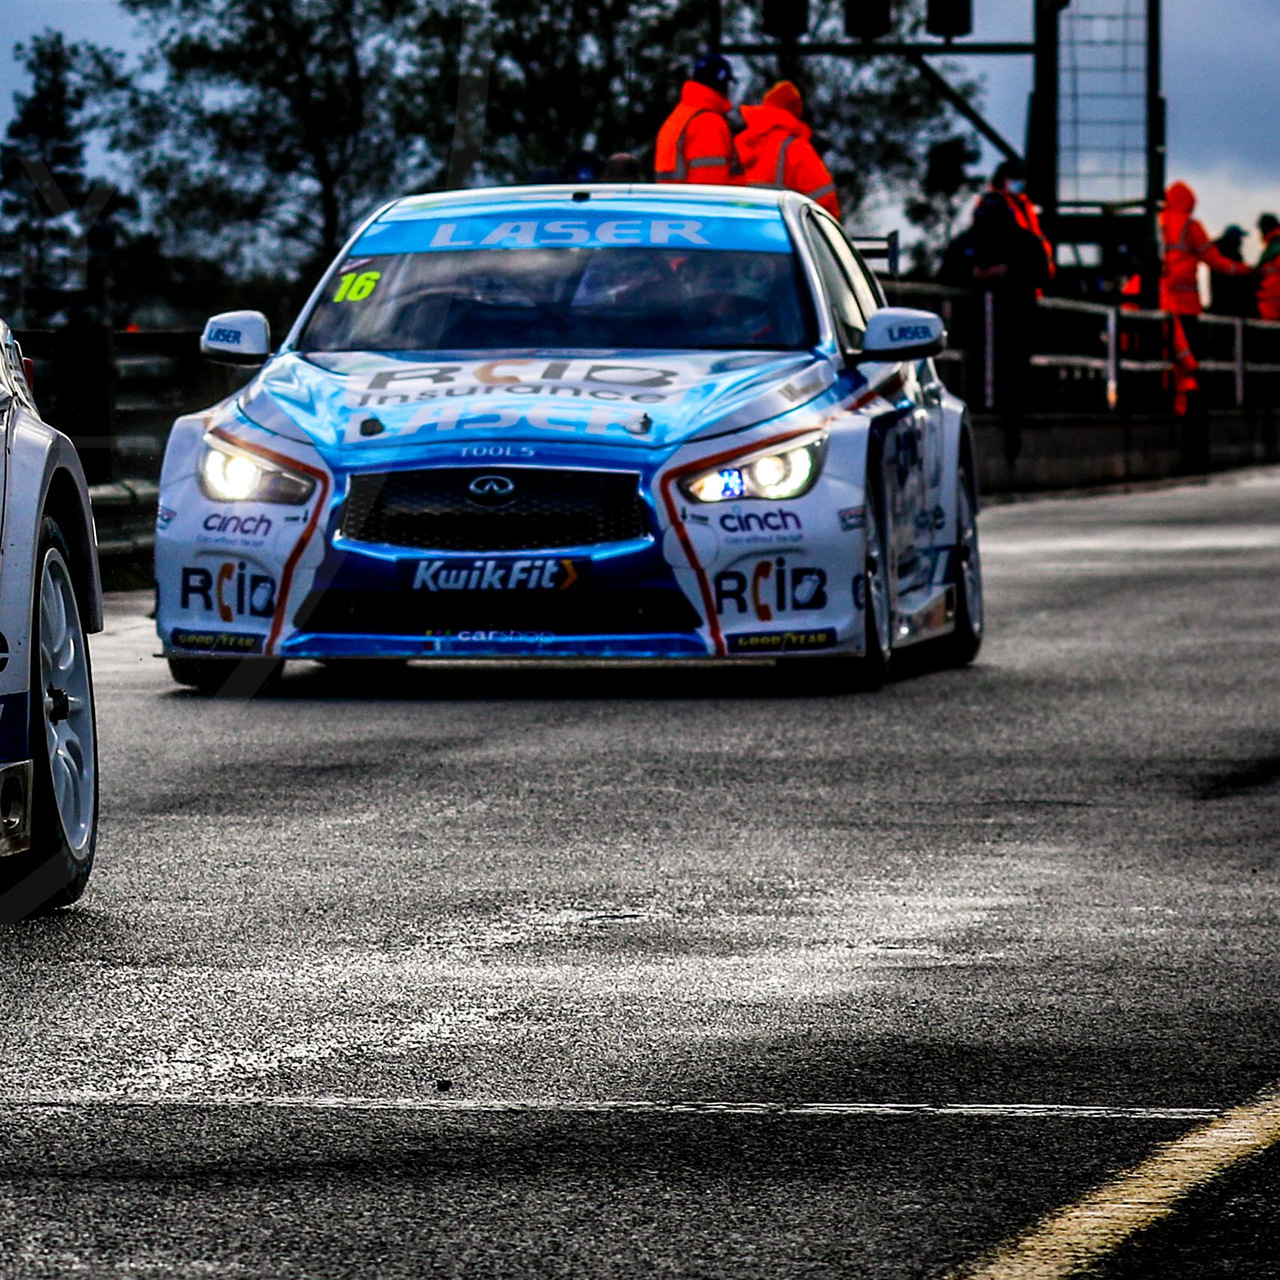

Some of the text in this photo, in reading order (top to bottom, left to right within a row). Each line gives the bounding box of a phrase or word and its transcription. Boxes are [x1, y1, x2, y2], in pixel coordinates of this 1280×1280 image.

[428, 220, 711, 248] LASER
[332, 271, 381, 303] 16
[206, 327, 242, 345] LASER
[887, 324, 932, 343] LASER
[357, 384, 667, 407] Insurance
[343, 400, 654, 444] LASER
[459, 445, 536, 458] TOOLS
[203, 511, 273, 537] cinch
[719, 505, 802, 533] cinch
